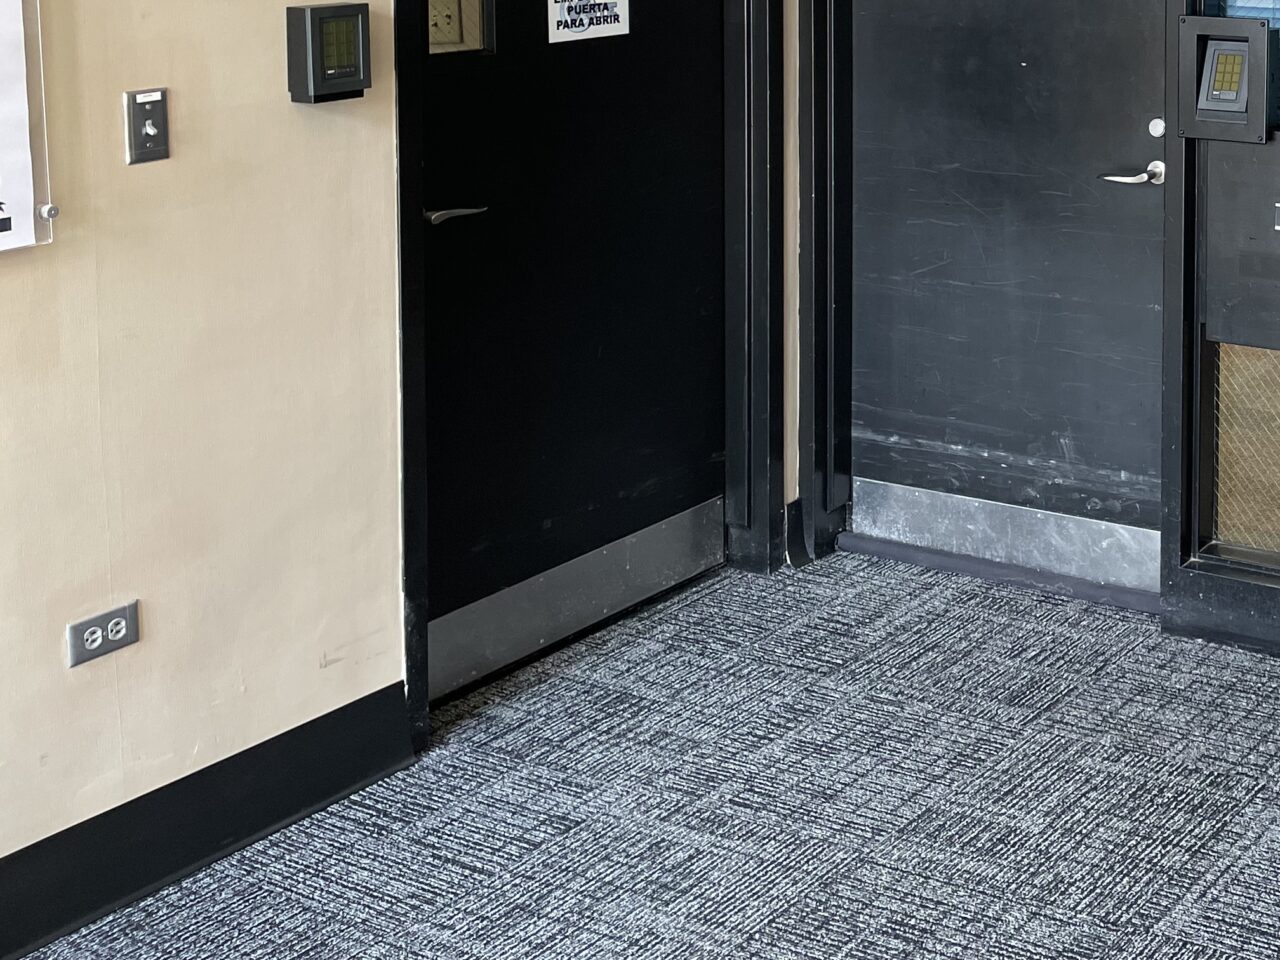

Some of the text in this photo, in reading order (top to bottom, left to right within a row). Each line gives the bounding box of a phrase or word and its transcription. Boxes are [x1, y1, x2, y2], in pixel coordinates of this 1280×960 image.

[567, 2, 609, 16] PUERTA
[556, 14, 620, 31] PARA ABRIR
